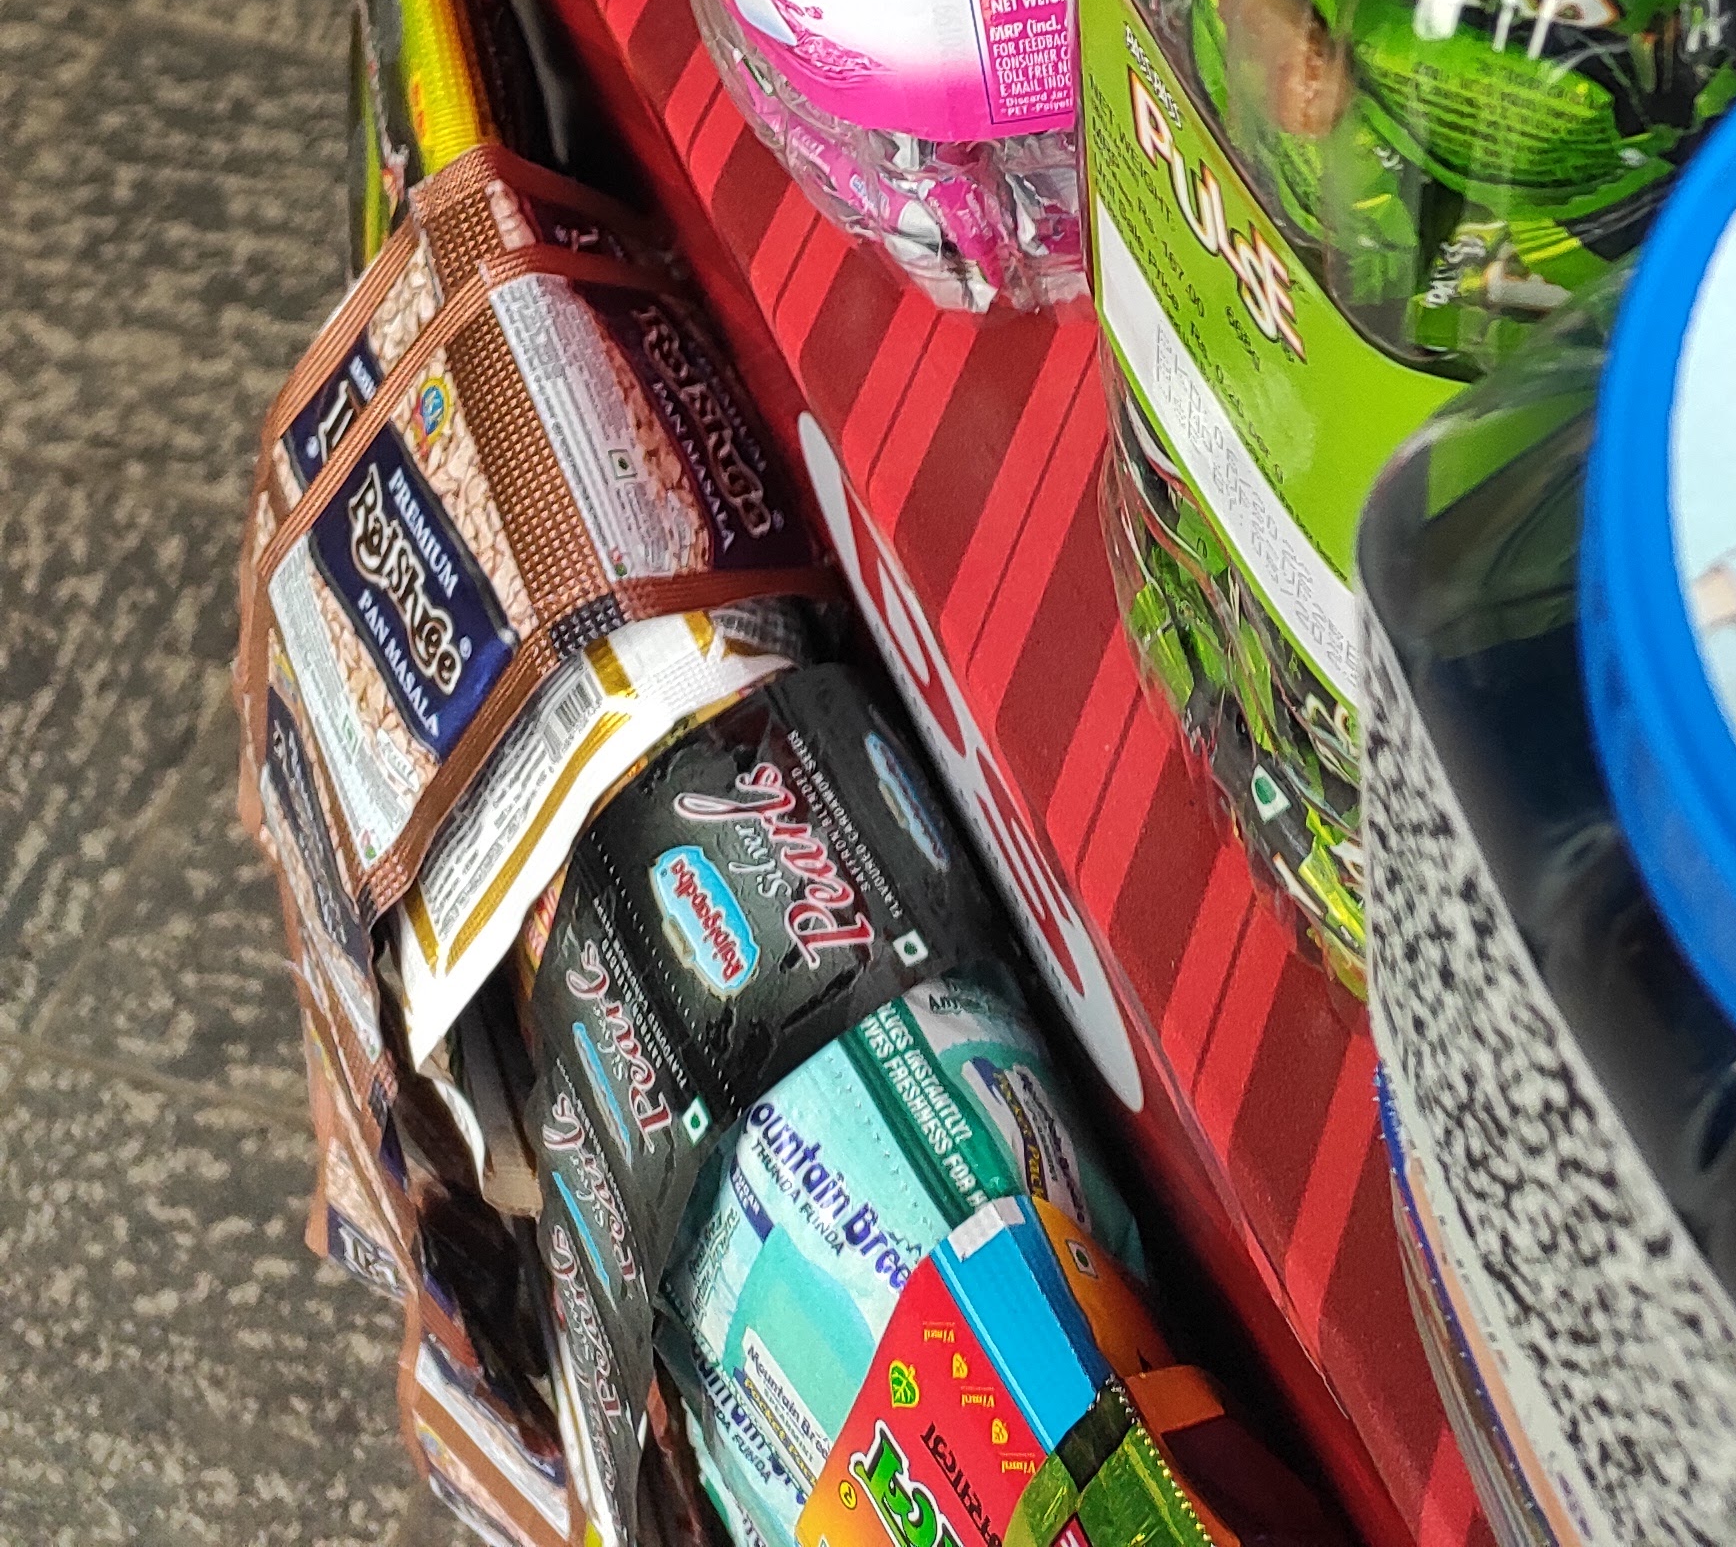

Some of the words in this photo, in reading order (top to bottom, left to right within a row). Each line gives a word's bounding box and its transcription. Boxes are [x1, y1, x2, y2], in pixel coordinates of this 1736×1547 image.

[989, 22, 1023, 42] MRP
[996, 48, 1057, 69] CONSUMER
[997, 69, 1025, 84] TOLL
[1028, 63, 1055, 79] FREE
[1128, 65, 1308, 364] PULSE
[349, 462, 464, 696] Rajshree
[386, 467, 461, 599] PREMIUM
[356, 595, 389, 646] PAN
[383, 646, 440, 737] MASALA
[674, 760, 874, 971] Pearls
[729, 822, 791, 898] Silver
[567, 940, 673, 1154] Pearls
[898, 1047, 977, 1146] INSTANTLY!
[876, 1054, 959, 1157] FRESHNESS
[940, 1150, 979, 1194] FOR
[798, 1203, 846, 1257] FUNDA
[741, 1345, 808, 1421] Mountain
